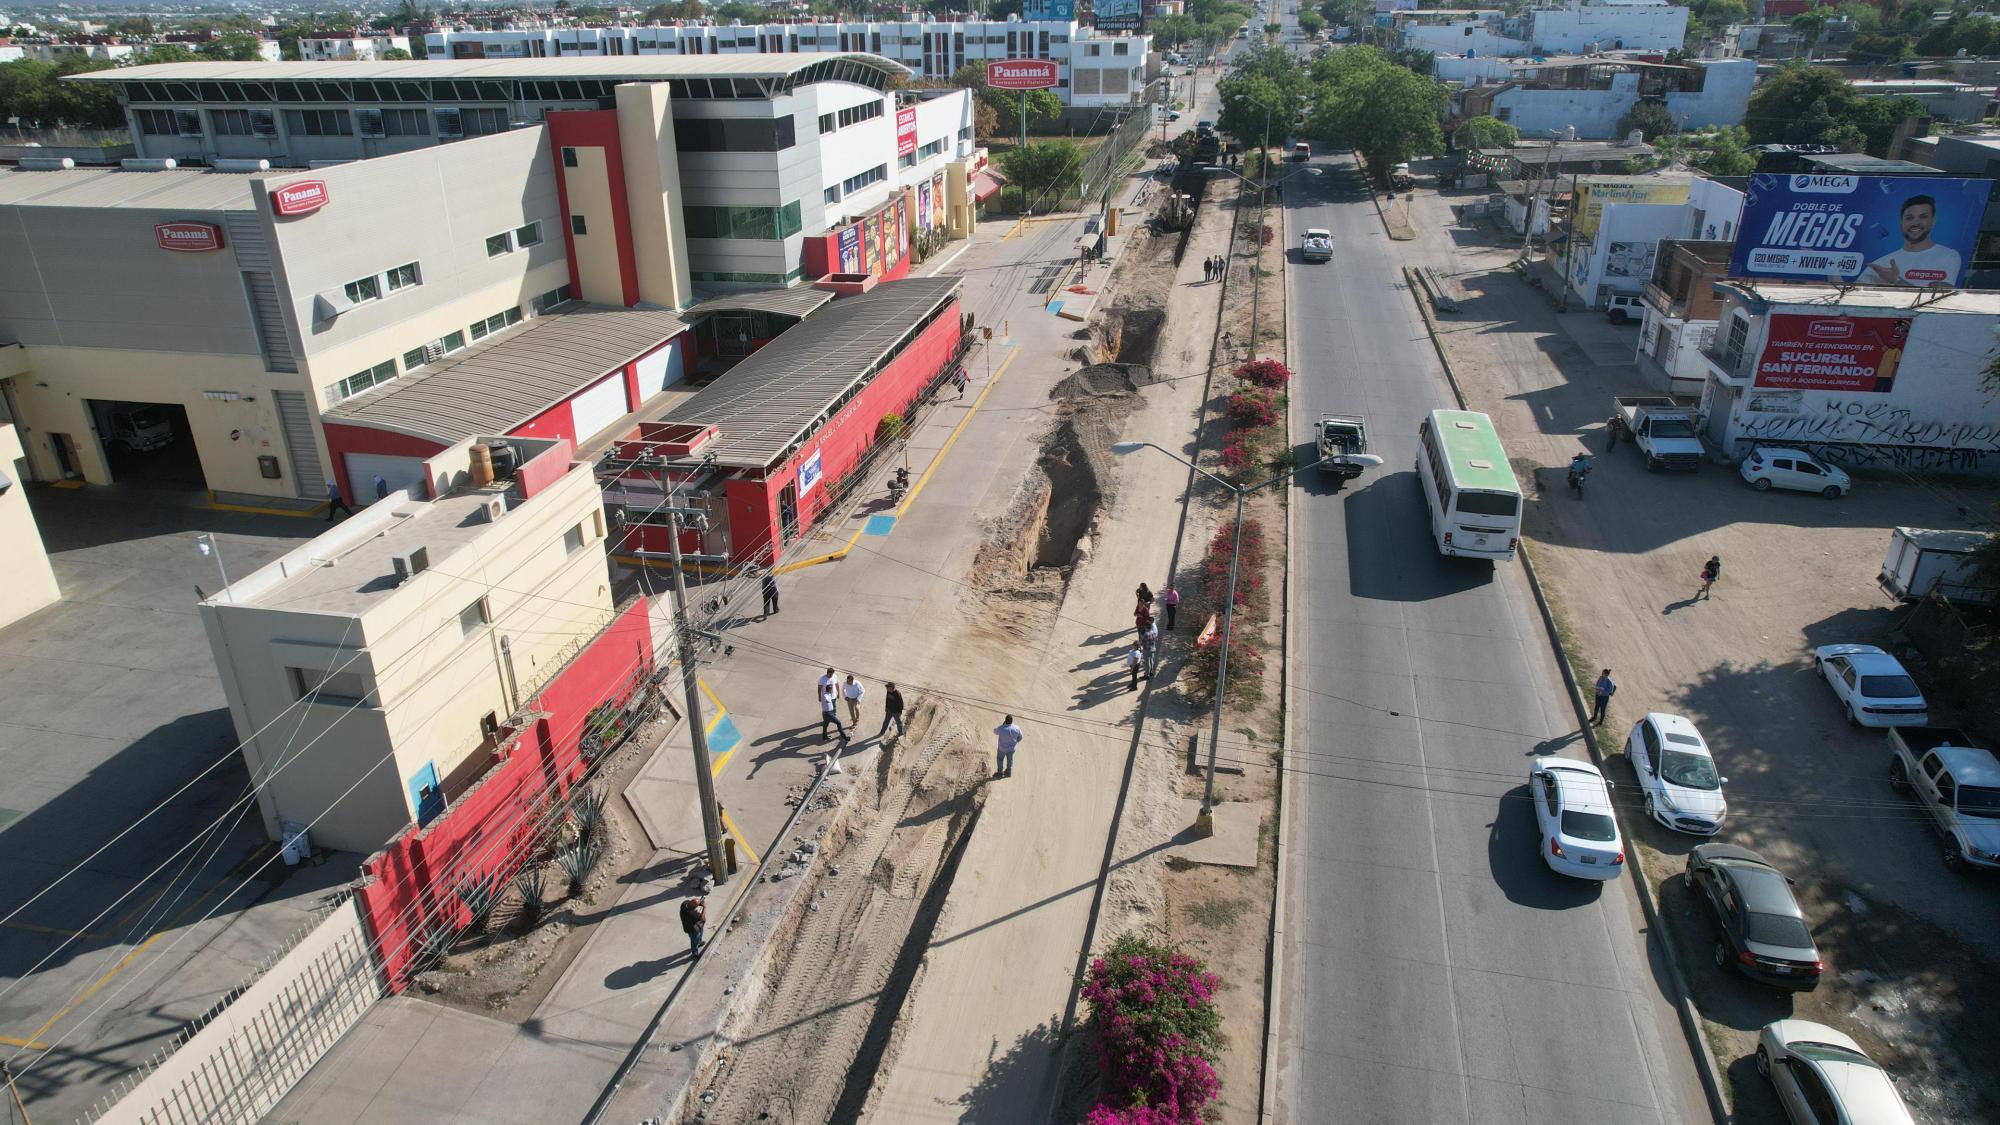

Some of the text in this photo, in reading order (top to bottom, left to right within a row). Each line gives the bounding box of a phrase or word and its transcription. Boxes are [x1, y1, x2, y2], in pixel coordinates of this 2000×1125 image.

[994, 65, 1050, 77] Panamá
[1811, 176, 1850, 187] MEGA
[283, 184, 321, 203] Panamá
[1792, 203, 1826, 211] DOBLE
[162, 228, 209, 239] Panamá
[1761, 211, 1864, 248] MEGAS
[1754, 253, 1765, 263] 120
[1766, 254, 1790, 264] MEGAS
[1908, 270, 1945, 279] mega.mx
[1814, 324, 1848, 332] Panamá
[1780, 351, 1857, 365] SUCURSAL
[1761, 362, 1875, 377] SAN FERNANDO
